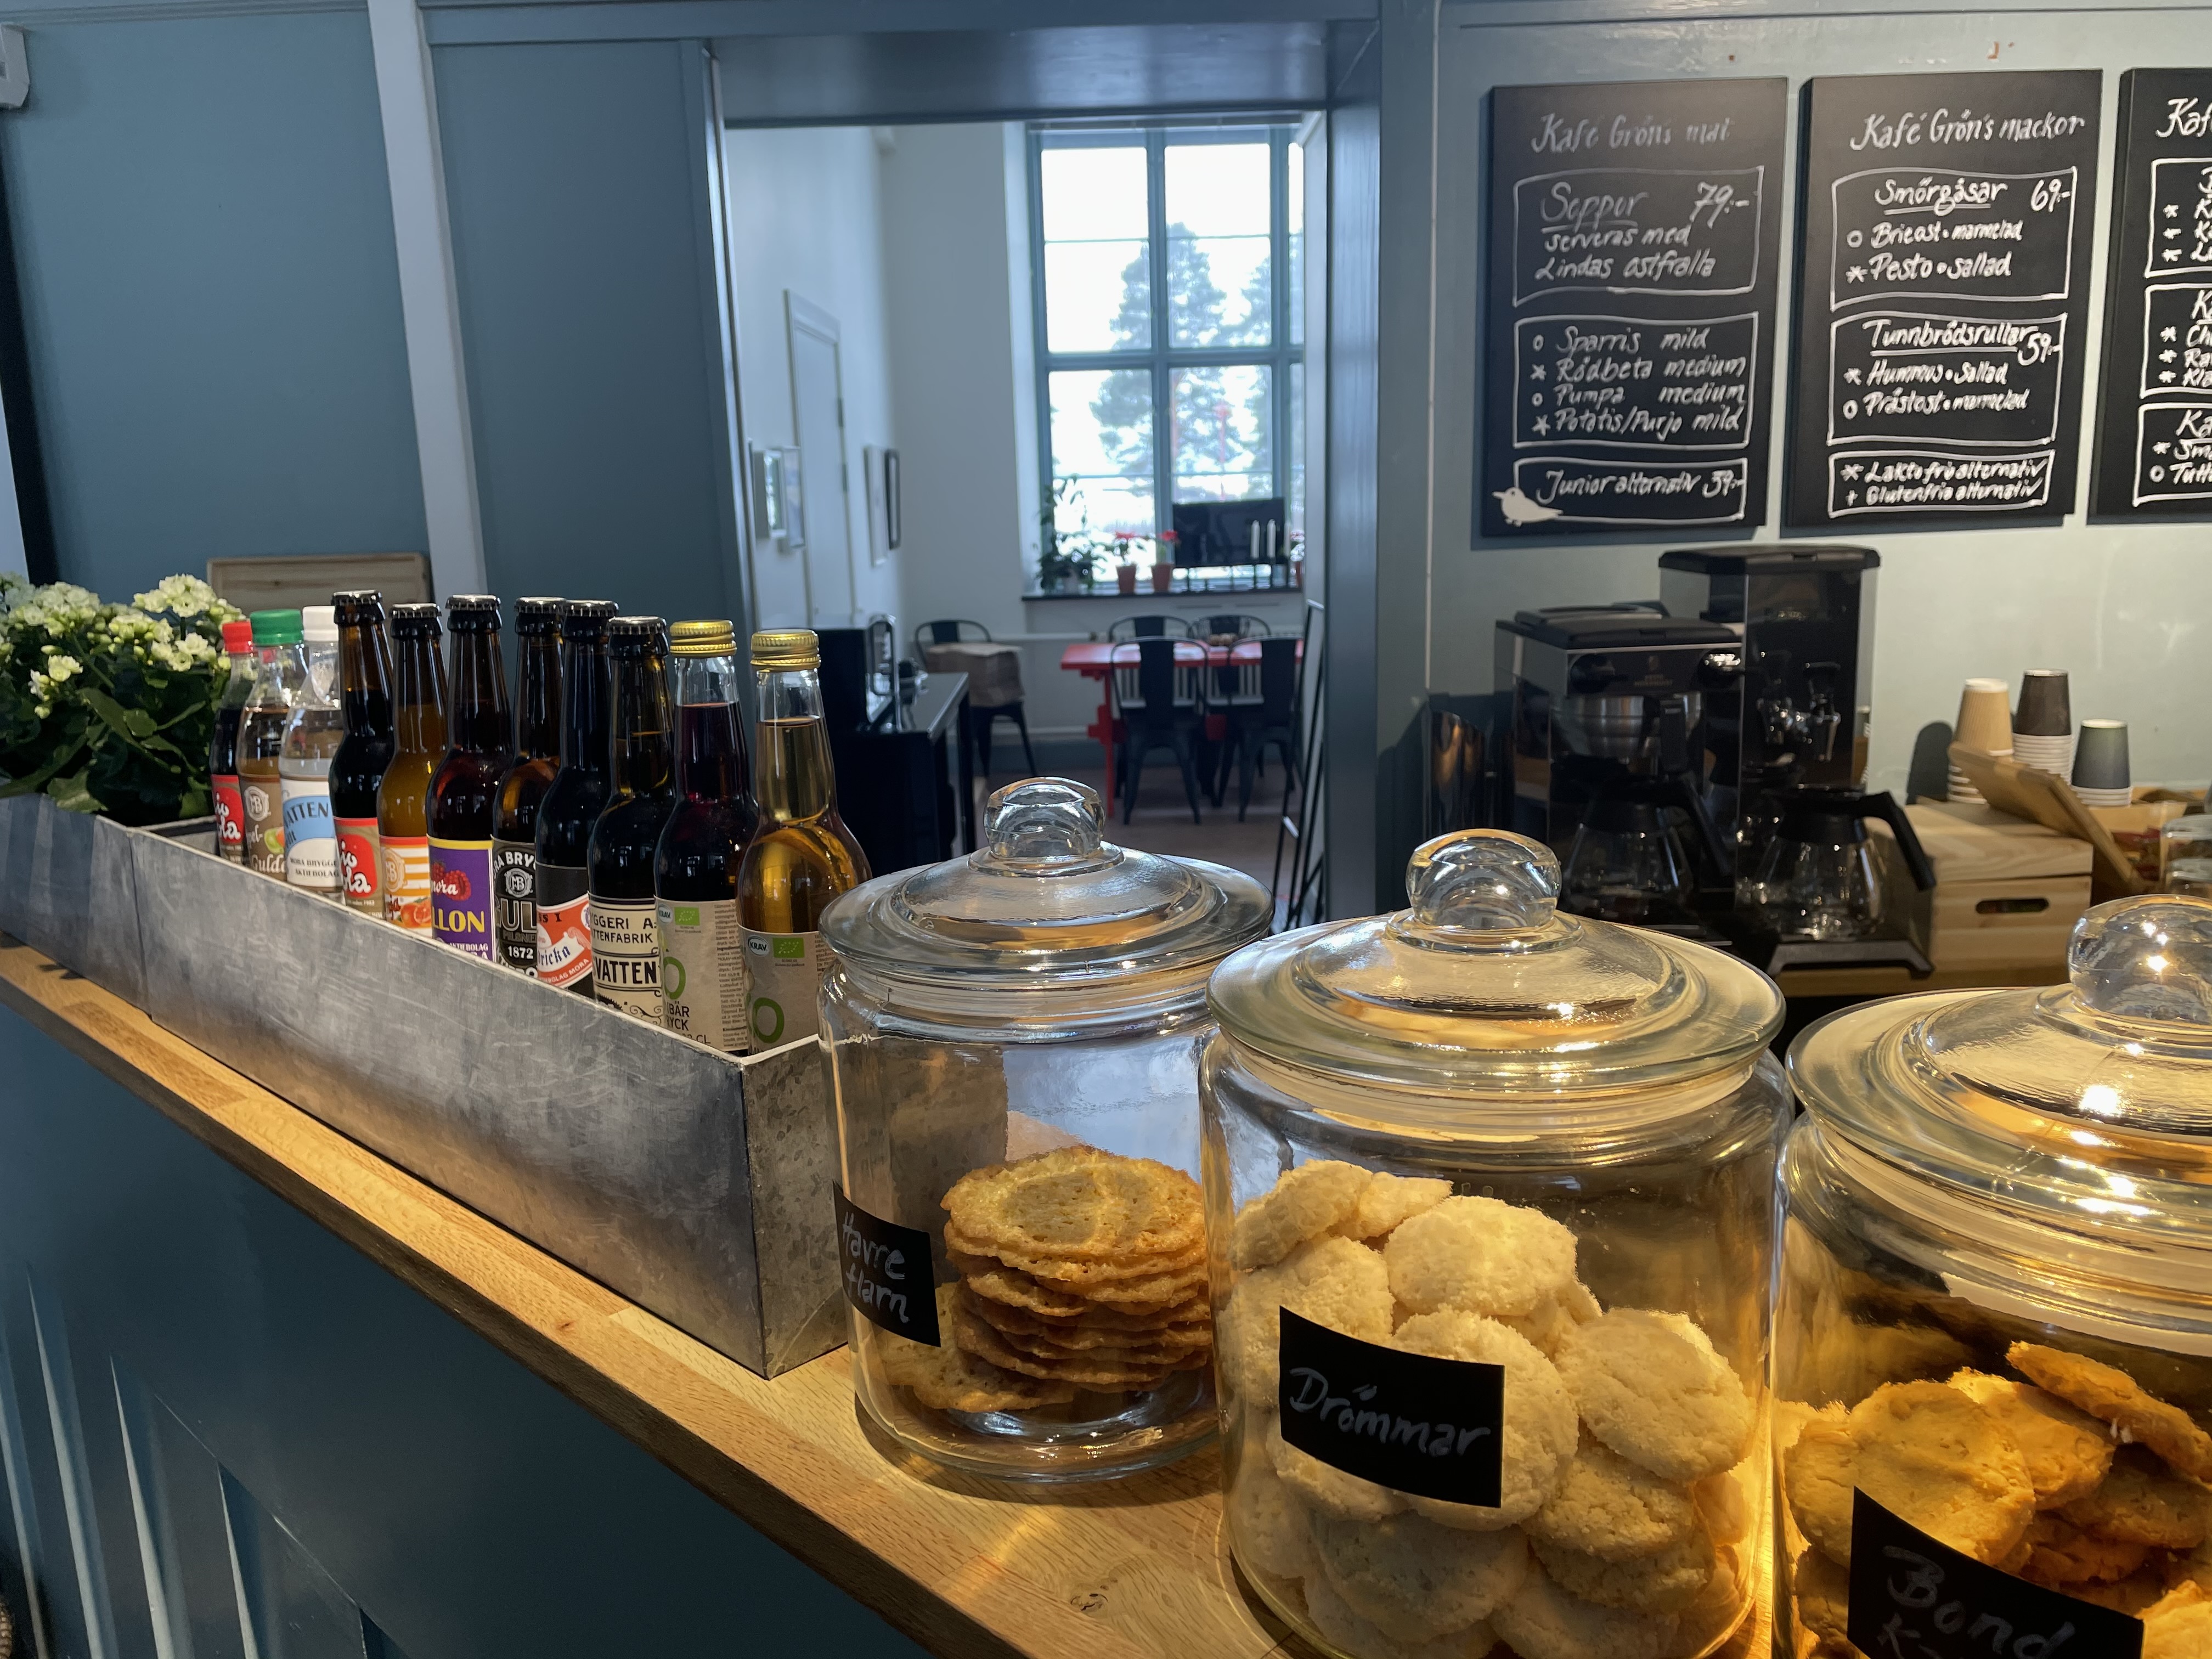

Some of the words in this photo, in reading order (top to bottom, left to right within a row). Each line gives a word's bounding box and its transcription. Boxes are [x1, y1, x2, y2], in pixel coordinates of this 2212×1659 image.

[1998, 111, 2085, 143] mackor
[2155, 97, 2212, 138] Kaf
[1874, 176, 2008, 216] Smörgåsar
[1544, 228, 1639, 252] serveras
[1641, 223, 1692, 247] med
[1534, 253, 1614, 281] Lindas
[1869, 252, 1933, 281] Pesto
[1555, 325, 1641, 358] Sparris
[1660, 326, 1711, 351] mild
[1555, 356, 1654, 382] Rödbeta
[1663, 354, 1746, 379] medium
[1553, 383, 1626, 411] Pumpa
[1658, 382, 1746, 404] medium
[1691, 404, 1745, 432] mild
[507, 945, 534, 960] 1872
[749, 941, 767, 951] KRAV
[1289, 1367, 1491, 1457] Drömmar
[1882, 1544, 2076, 1659] Bond
